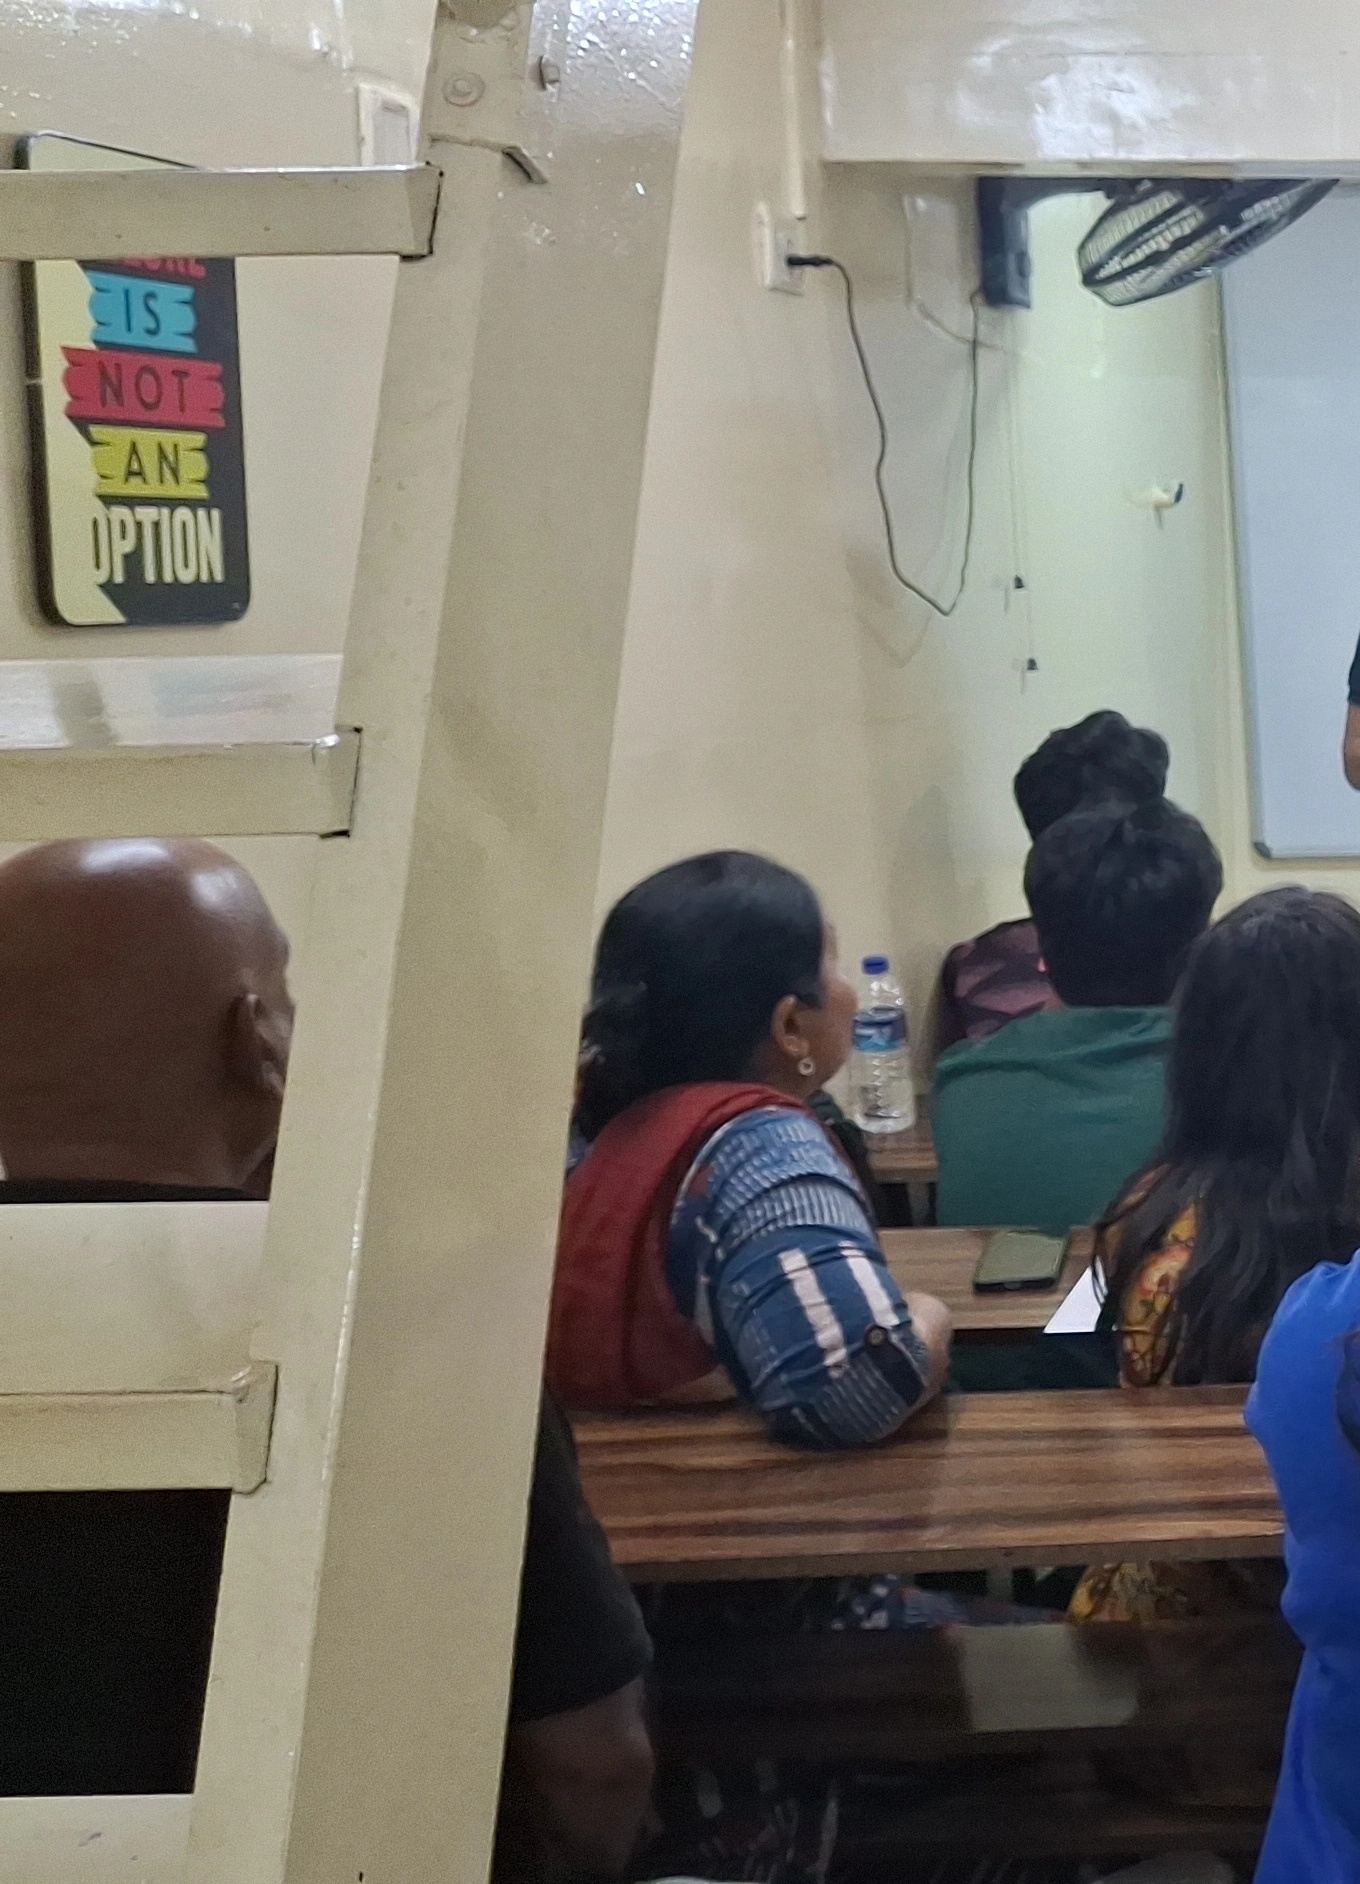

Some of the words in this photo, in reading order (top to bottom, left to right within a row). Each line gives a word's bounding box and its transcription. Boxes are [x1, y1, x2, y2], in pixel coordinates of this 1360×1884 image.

[124, 289, 162, 336] IS
[99, 359, 190, 413] NOT
[124, 441, 181, 487] AN
[89, 505, 225, 584] OPTION
